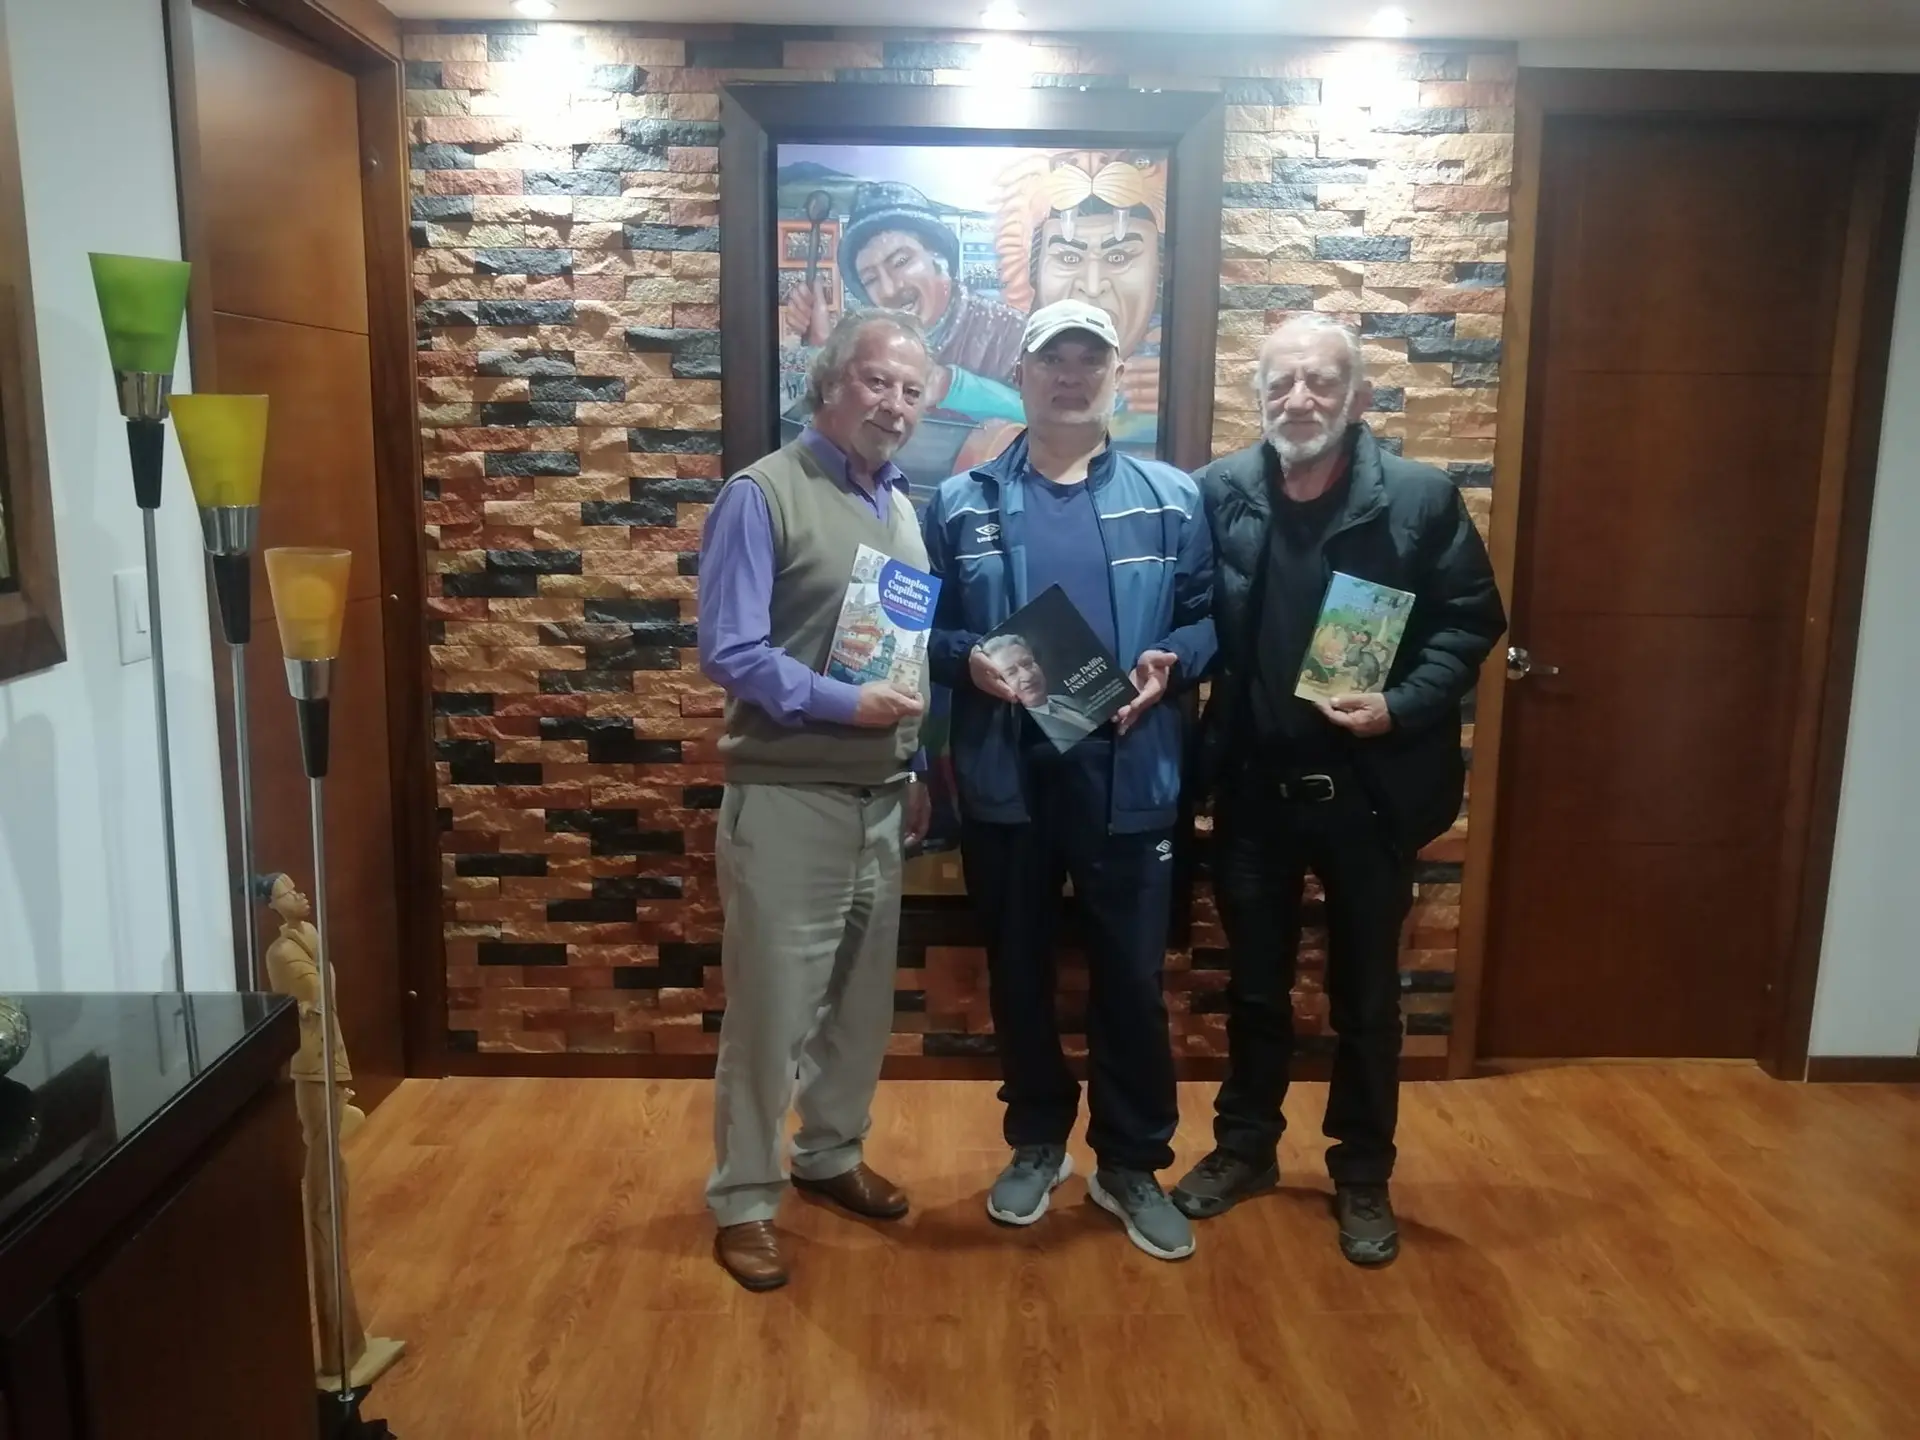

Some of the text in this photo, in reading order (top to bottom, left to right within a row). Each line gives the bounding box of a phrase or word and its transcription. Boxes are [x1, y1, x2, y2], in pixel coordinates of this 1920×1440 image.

[883, 588, 928, 613] Conventos
[888, 579, 932, 606] Capillas y
[1063, 672, 1081, 687] Luis
